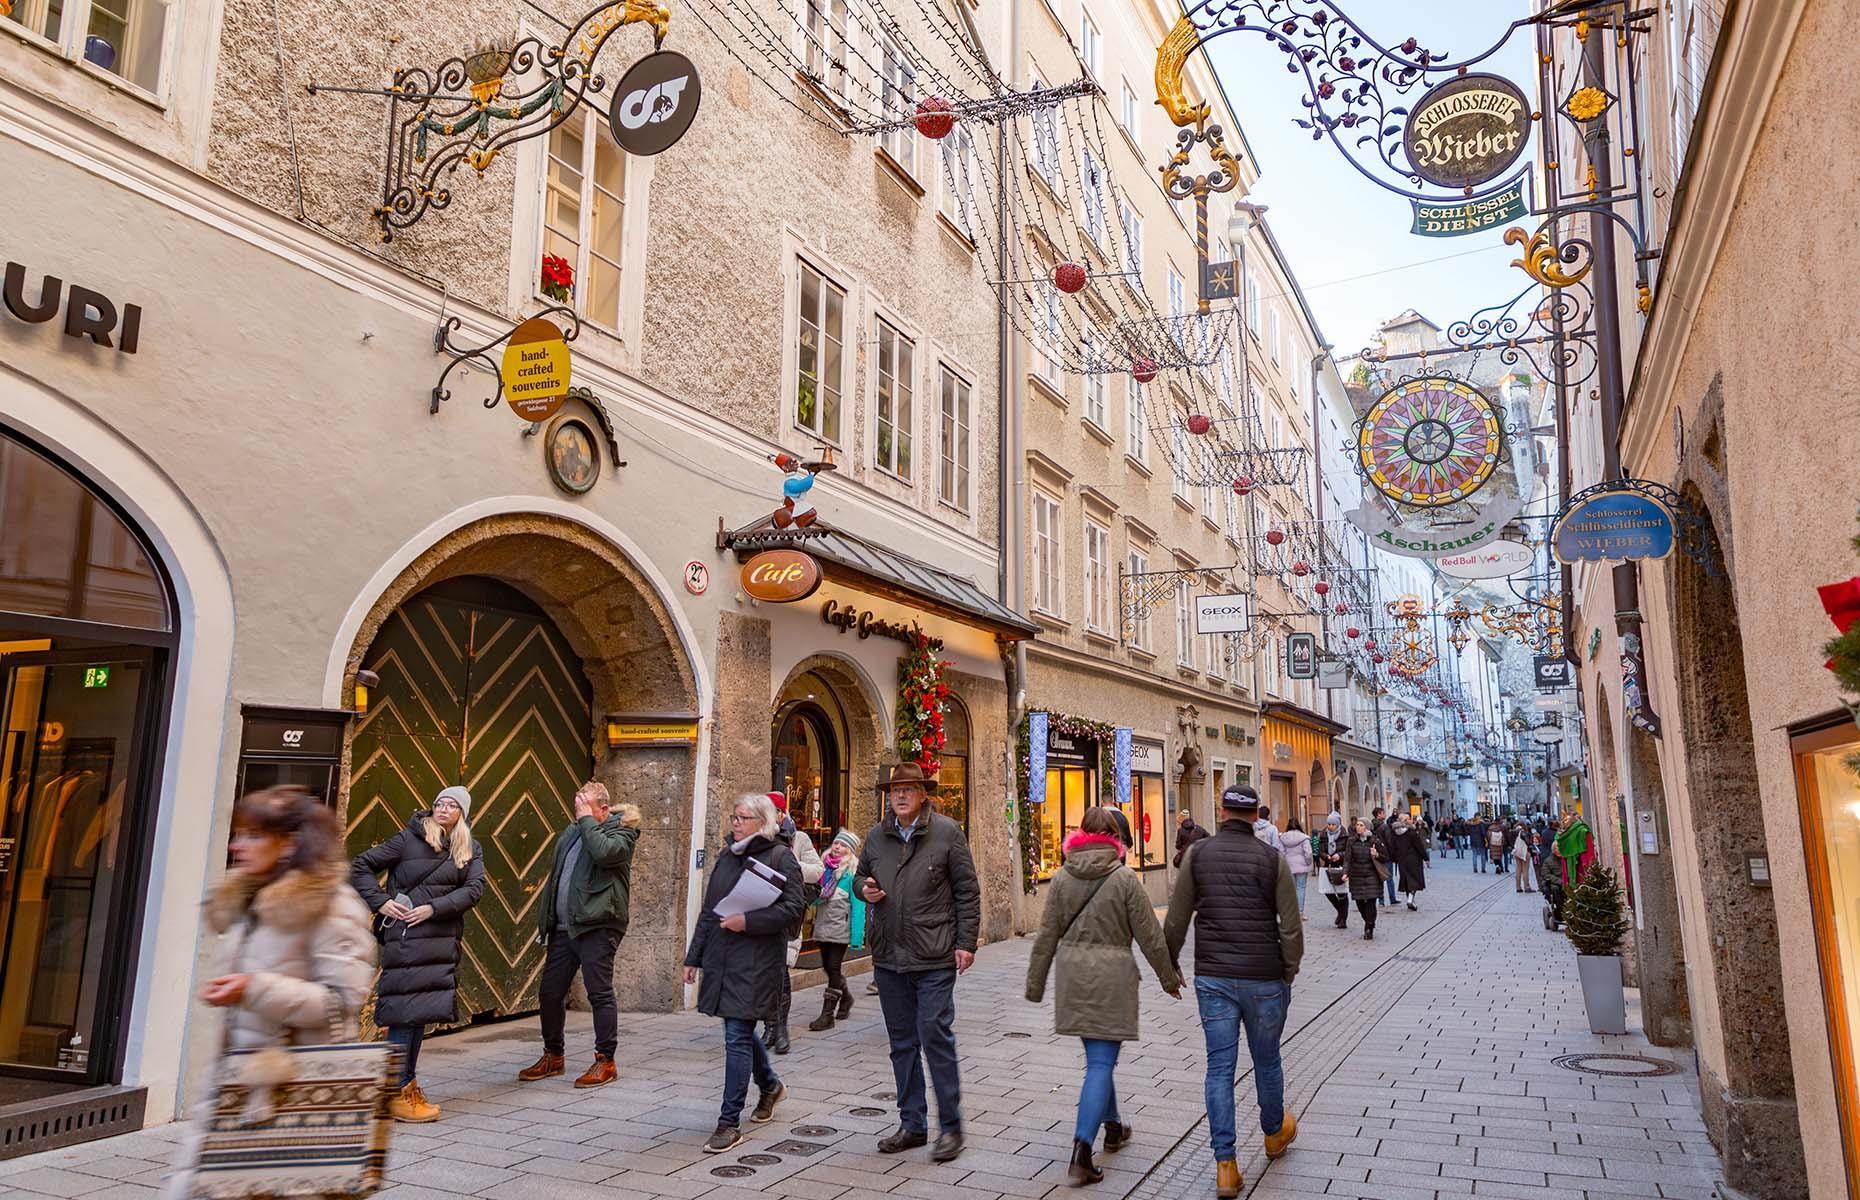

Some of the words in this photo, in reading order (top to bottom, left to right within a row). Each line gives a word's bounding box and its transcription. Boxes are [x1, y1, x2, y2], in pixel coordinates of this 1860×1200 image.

[1418, 93, 1516, 131] SCHLOSSEREI
[1414, 128, 1520, 167] Wieber
[1419, 189, 1520, 219] SCHLÜSSEL
[1425, 207, 1509, 232] DIENST
[2, 261, 142, 355] URI
[521, 347, 549, 362] hand-
[517, 361, 554, 377] crafted
[512, 377, 560, 393] souvenirs
[1585, 507, 1643, 519] Schlosserei
[1566, 518, 1663, 532] Schlüsseldienst
[1375, 522, 1496, 551] Aschauer
[1576, 535, 1652, 549] WIEBER
[750, 562, 804, 584] Café
[822, 599, 857, 633] Café
[1202, 606, 1241, 615] GEOX
